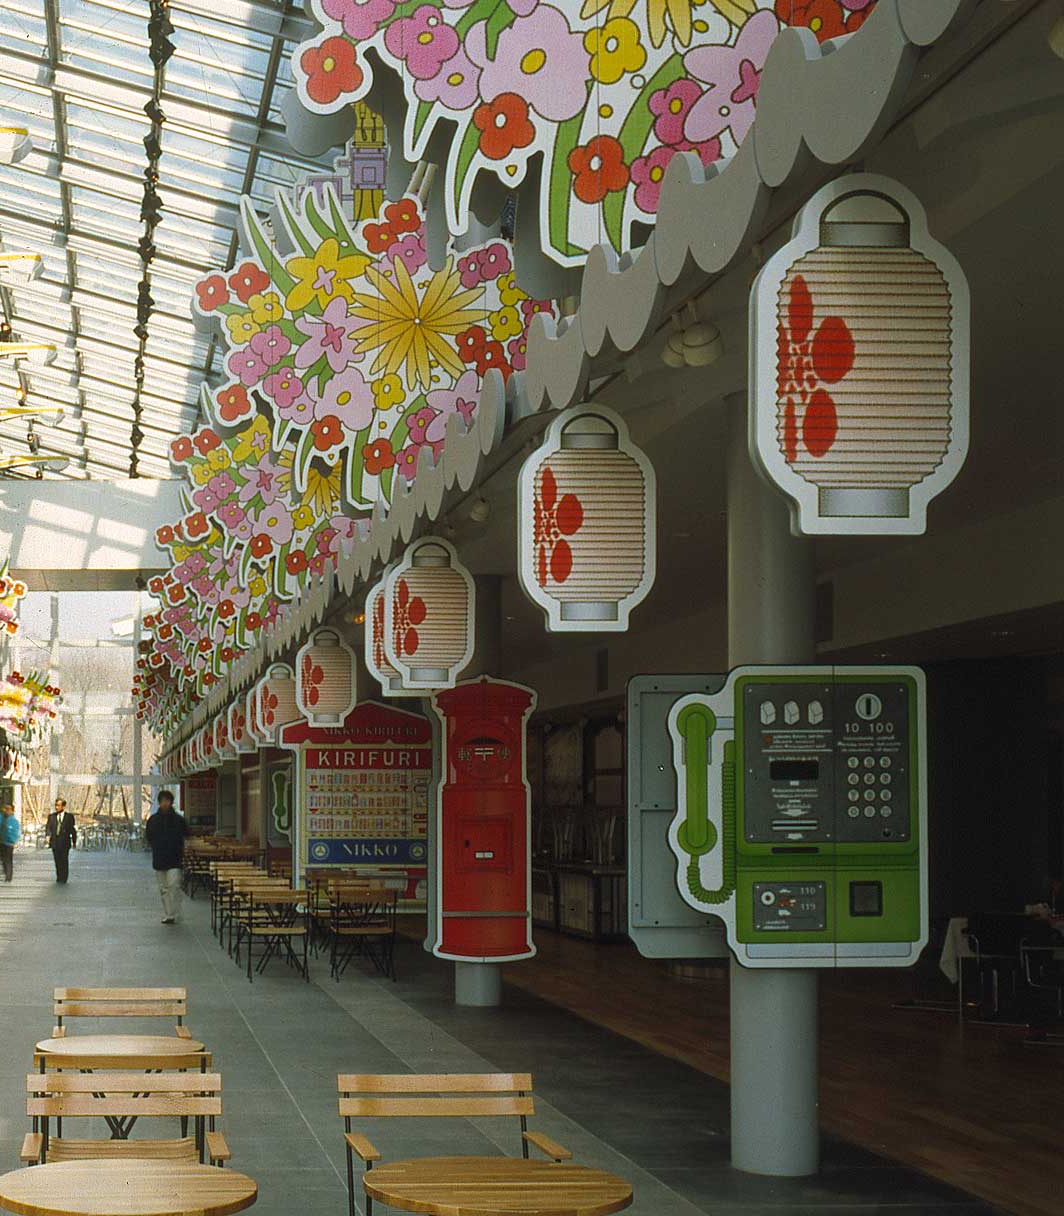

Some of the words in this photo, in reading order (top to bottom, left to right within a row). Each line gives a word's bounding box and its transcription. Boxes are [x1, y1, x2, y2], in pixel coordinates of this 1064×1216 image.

[323, 727, 360, 736] NIKKO
[844, 723, 860, 734] 10
[869, 723, 894, 734] 100
[318, 751, 420, 767] KIRIFURI
[342, 843, 398, 857] NIKKO
[800, 887, 816, 895] 110
